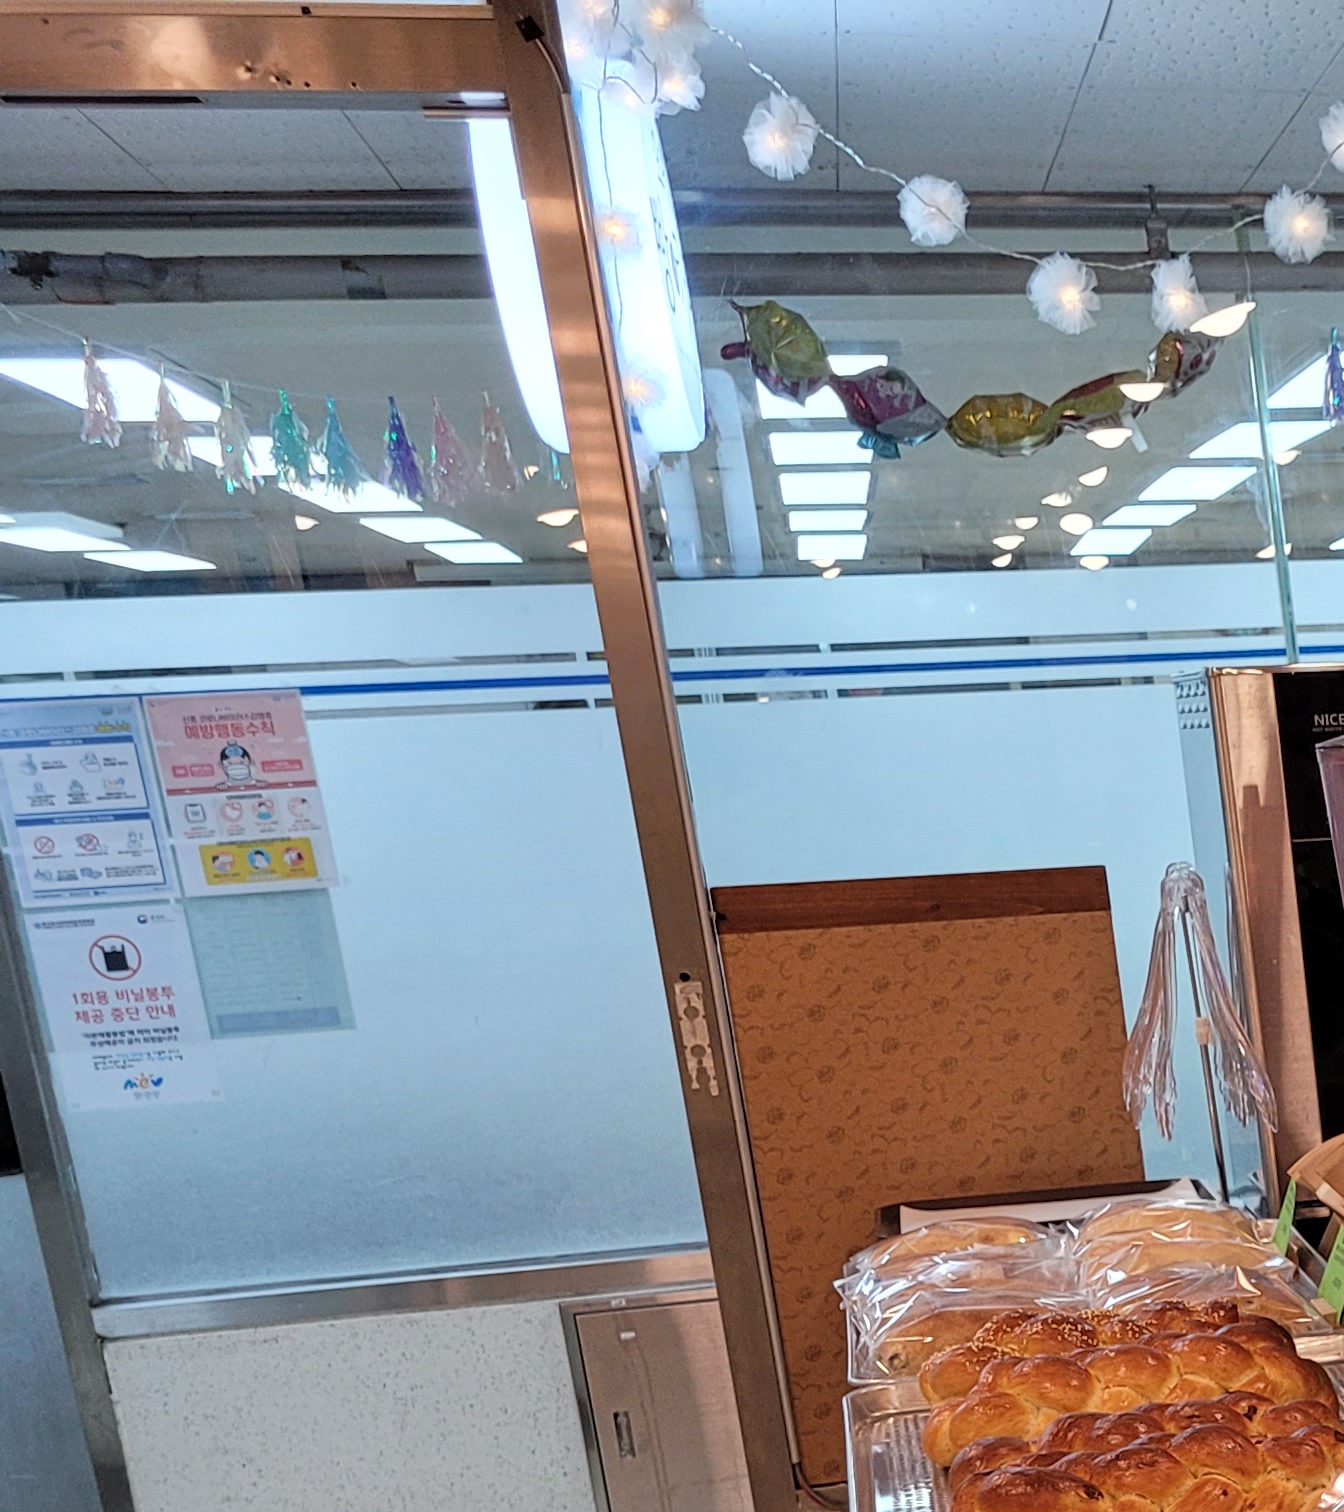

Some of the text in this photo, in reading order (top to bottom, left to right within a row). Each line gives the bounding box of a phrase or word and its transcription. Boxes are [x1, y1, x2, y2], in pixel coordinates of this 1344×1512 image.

[72, 985, 176, 1007] 1회용 비닐봉투
[73, 1003, 176, 1025] 제공 중단 안내
